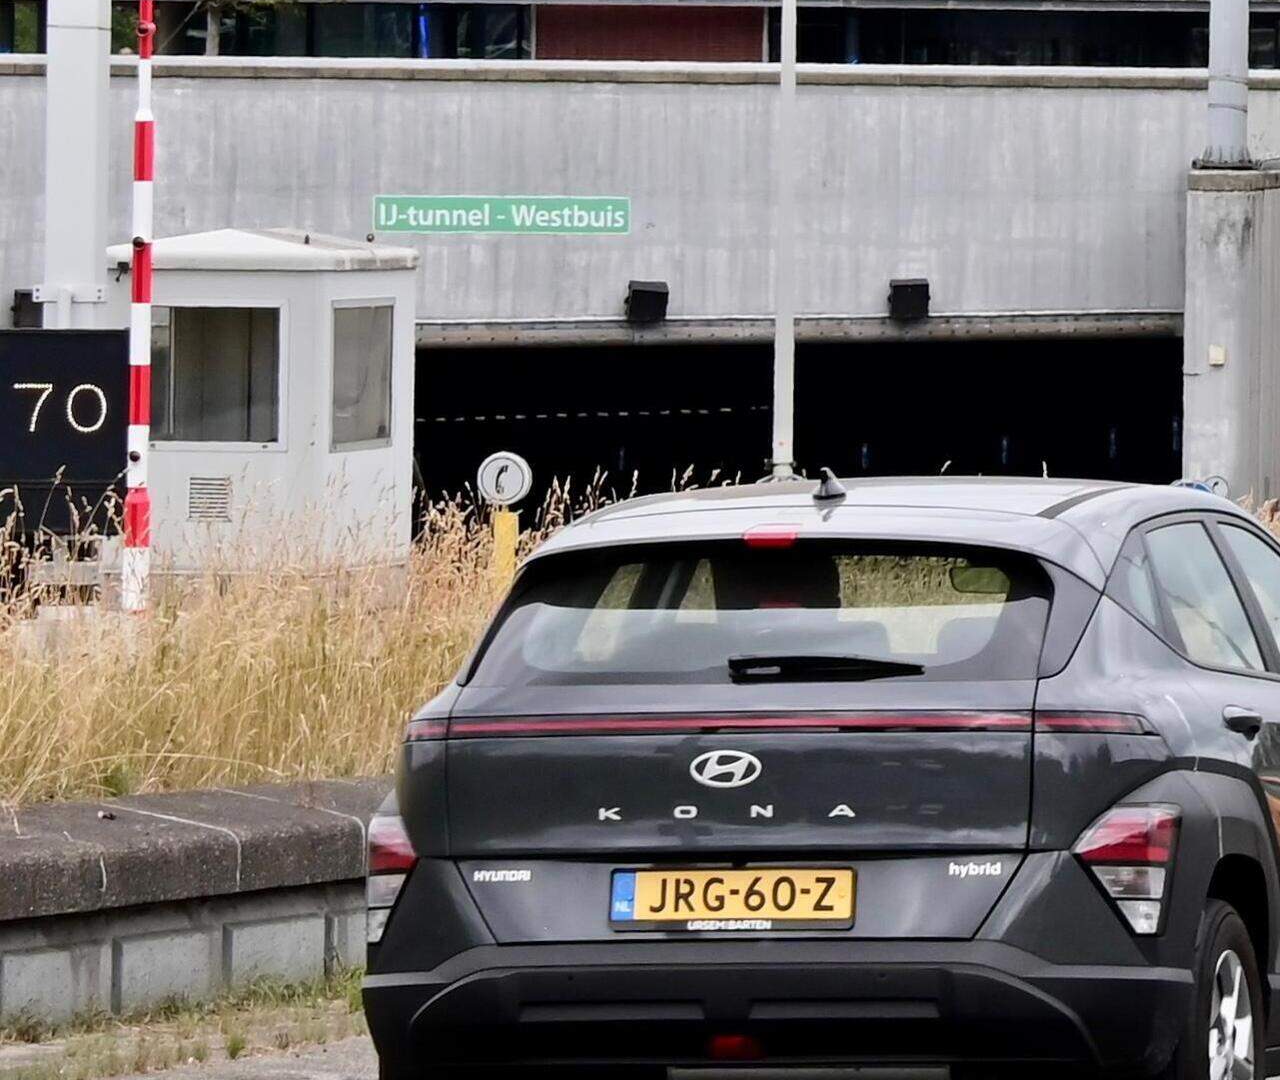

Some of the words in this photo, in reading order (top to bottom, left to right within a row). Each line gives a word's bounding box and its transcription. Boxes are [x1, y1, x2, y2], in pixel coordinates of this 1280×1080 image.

[379, 203, 490, 227] IJ-tunnel
[511, 204, 625, 228] Westbuis
[13, 383, 107, 432] 70
[598, 804, 856, 821] KONA
[473, 869, 532, 882] HYUNDAI
[948, 862, 1002, 878] hybrid
[649, 876, 836, 913] JRG-60-Z
[615, 901, 631, 912] NL
